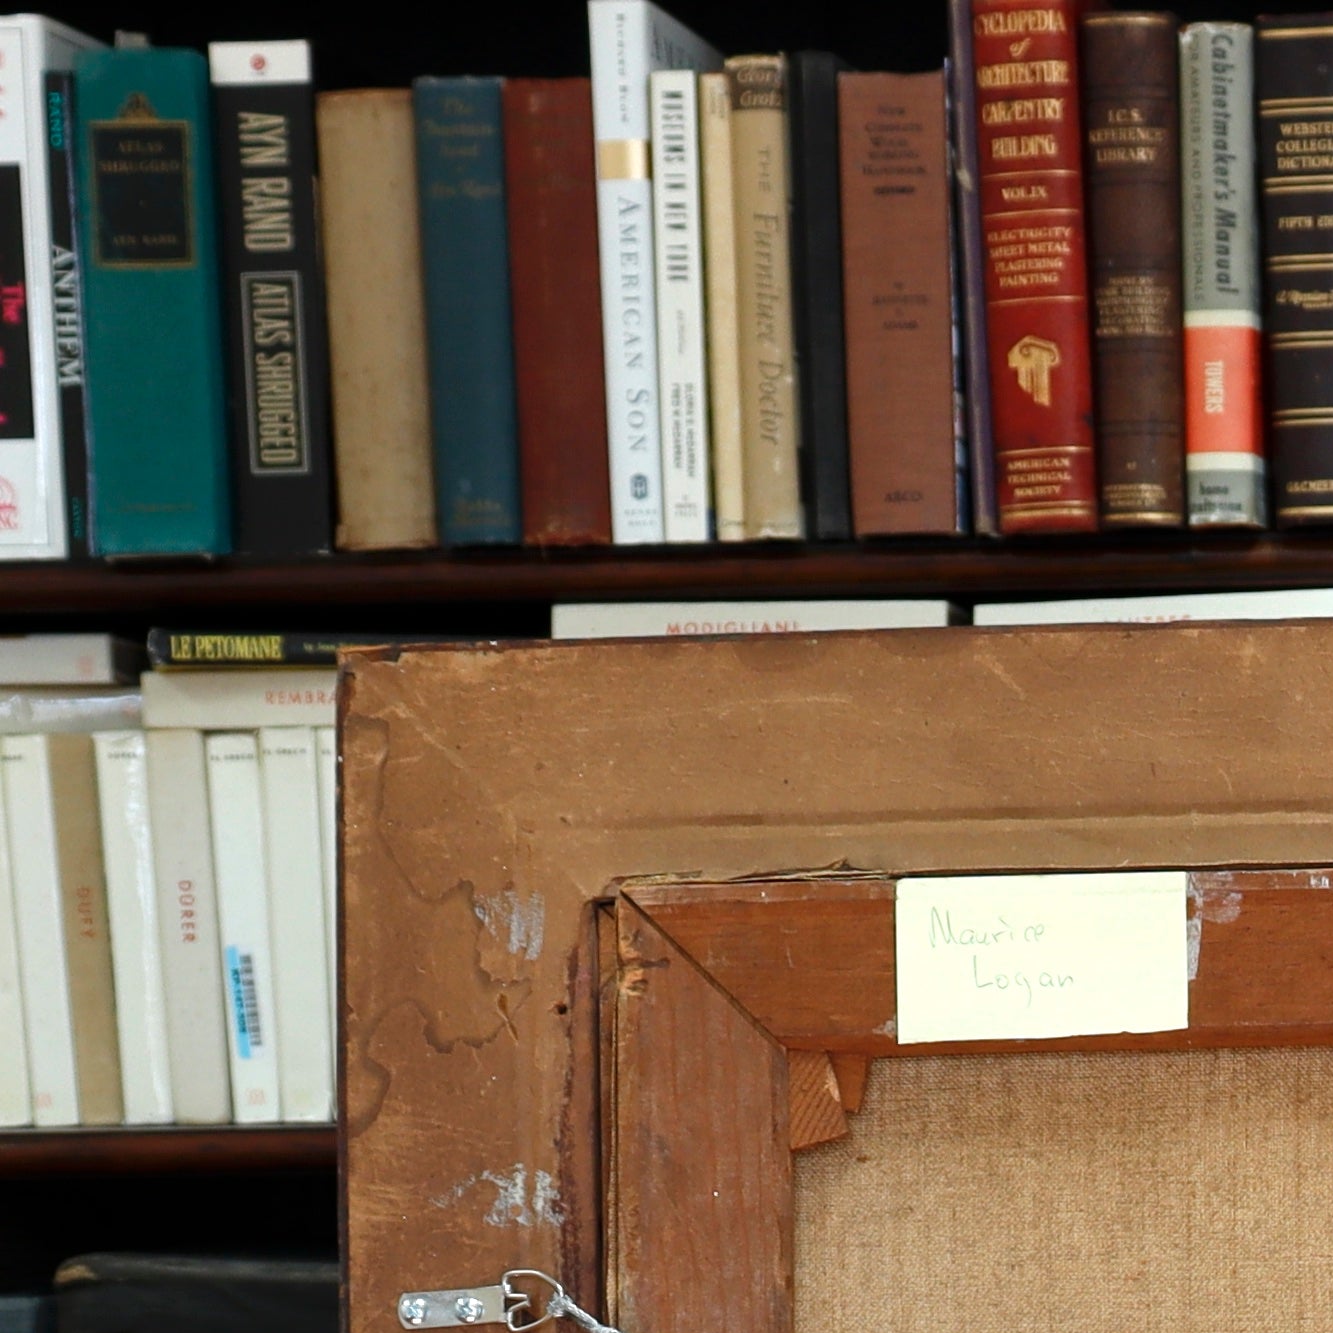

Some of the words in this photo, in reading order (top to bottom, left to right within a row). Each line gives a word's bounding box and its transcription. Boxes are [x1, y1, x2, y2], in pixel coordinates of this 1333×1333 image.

[975, 9, 1067, 35] CYCLOPEDIA
[1009, 38, 1032, 57] of
[977, 60, 1070, 88] ARCHITECTURE
[661, 90, 687, 165] MUSEUMS
[982, 98, 1064, 125] CARPENTRY
[1211, 33, 1237, 201] Cabinetmaker's
[238, 111, 288, 167] AYN
[991, 134, 1057, 160] BUILDING
[1096, 146, 1158, 163] LIBRARY
[242, 177, 295, 254] RAND
[987, 226, 1072, 243] ELECTRICITY
[1278, 214, 1313, 229] FIFTH
[666, 244, 690, 285] YORK
[1027, 241, 1070, 254] METAL
[1214, 206, 1240, 295] Manual
[616, 194, 647, 371] AMERICAN
[753, 211, 782, 346] Furniture
[999, 273, 1060, 288] PAINTING
[51, 242, 82, 389] ANTHEM
[252, 282, 293, 347] ATLAS
[256, 350, 298, 463] SHRUGGED
[757, 359, 785, 447] Doctor
[1204, 360, 1225, 415] TOWERS
[628, 389, 651, 454] SON
[1007, 456, 1072, 471] AMERICAN
[170, 635, 192, 660] LE
[194, 634, 284, 661] PETOMANE
[666, 620, 801, 635] MODIGLIANI
[75, 884, 97, 941] DUFY
[177, 879, 196, 944] DÜRER
[928, 905, 1046, 949] Maurice
[972, 954, 1075, 1008] Logan
